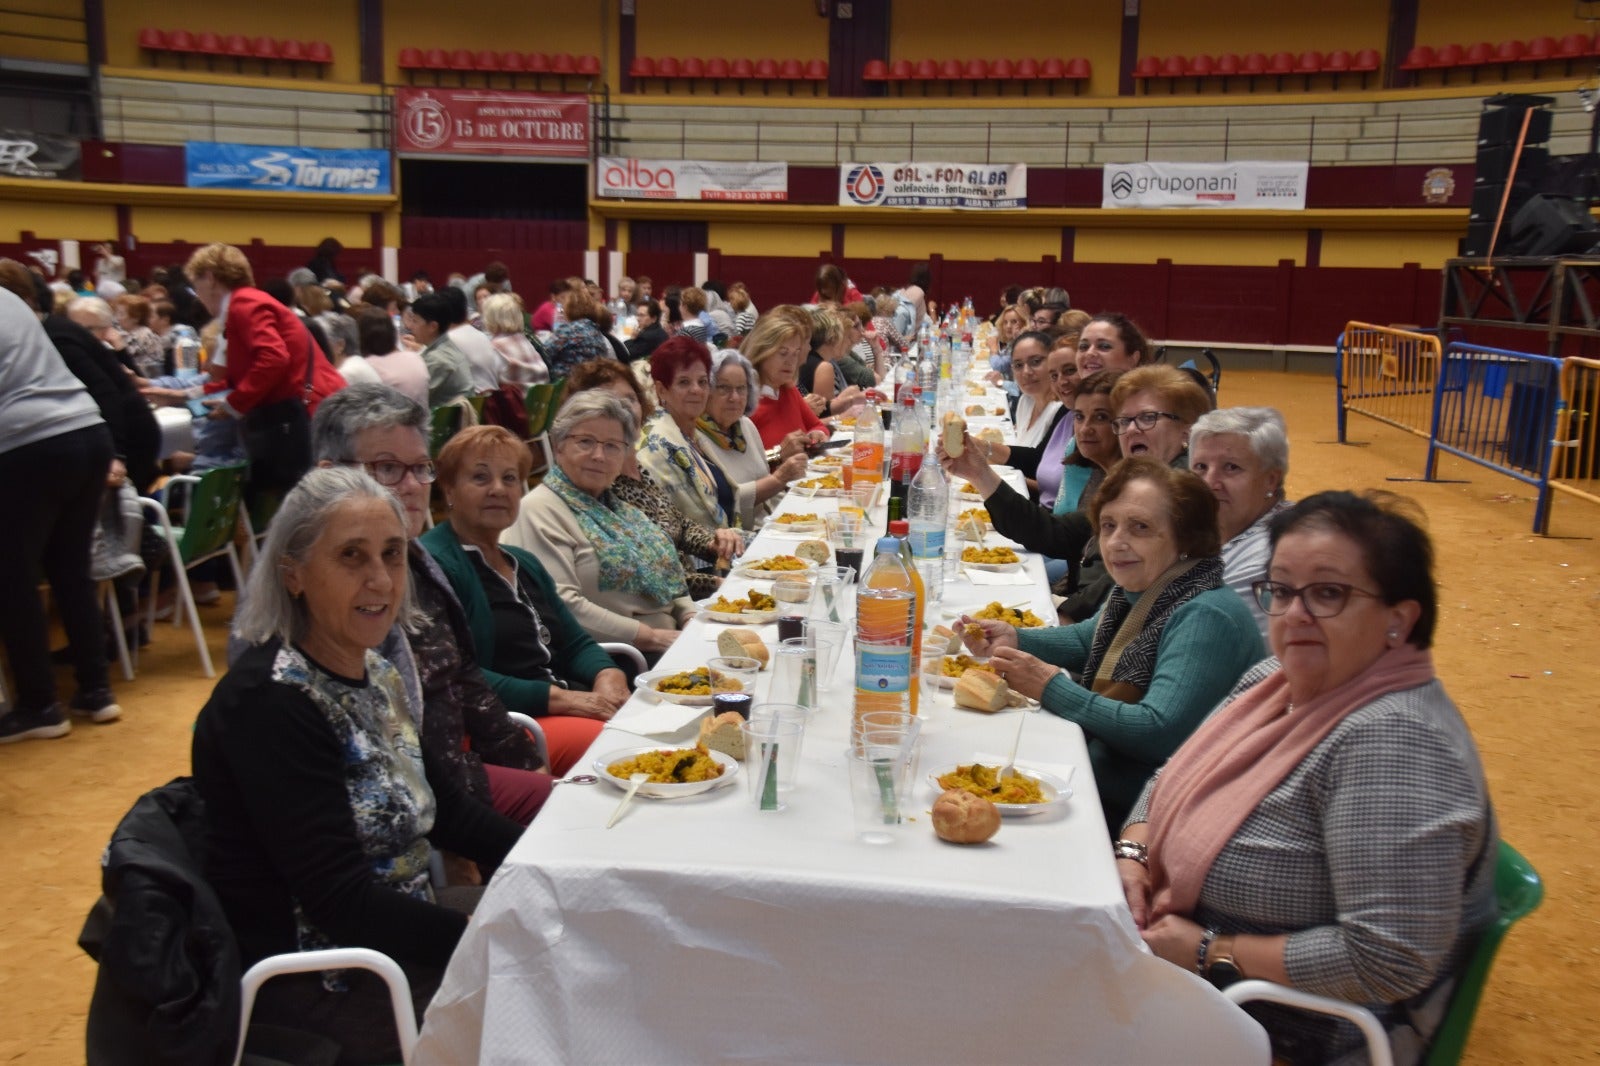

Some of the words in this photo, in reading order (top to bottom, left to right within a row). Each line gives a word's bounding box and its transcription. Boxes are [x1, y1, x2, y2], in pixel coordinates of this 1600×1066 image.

[416, 110, 441, 138] 15
[456, 119, 473, 137] 15
[479, 124, 497, 138] DE
[502, 119, 585, 141] OCTUBRE
[290, 157, 380, 189] Tormes
[605, 158, 676, 189] alba
[1136, 172, 1238, 194] gruponani
